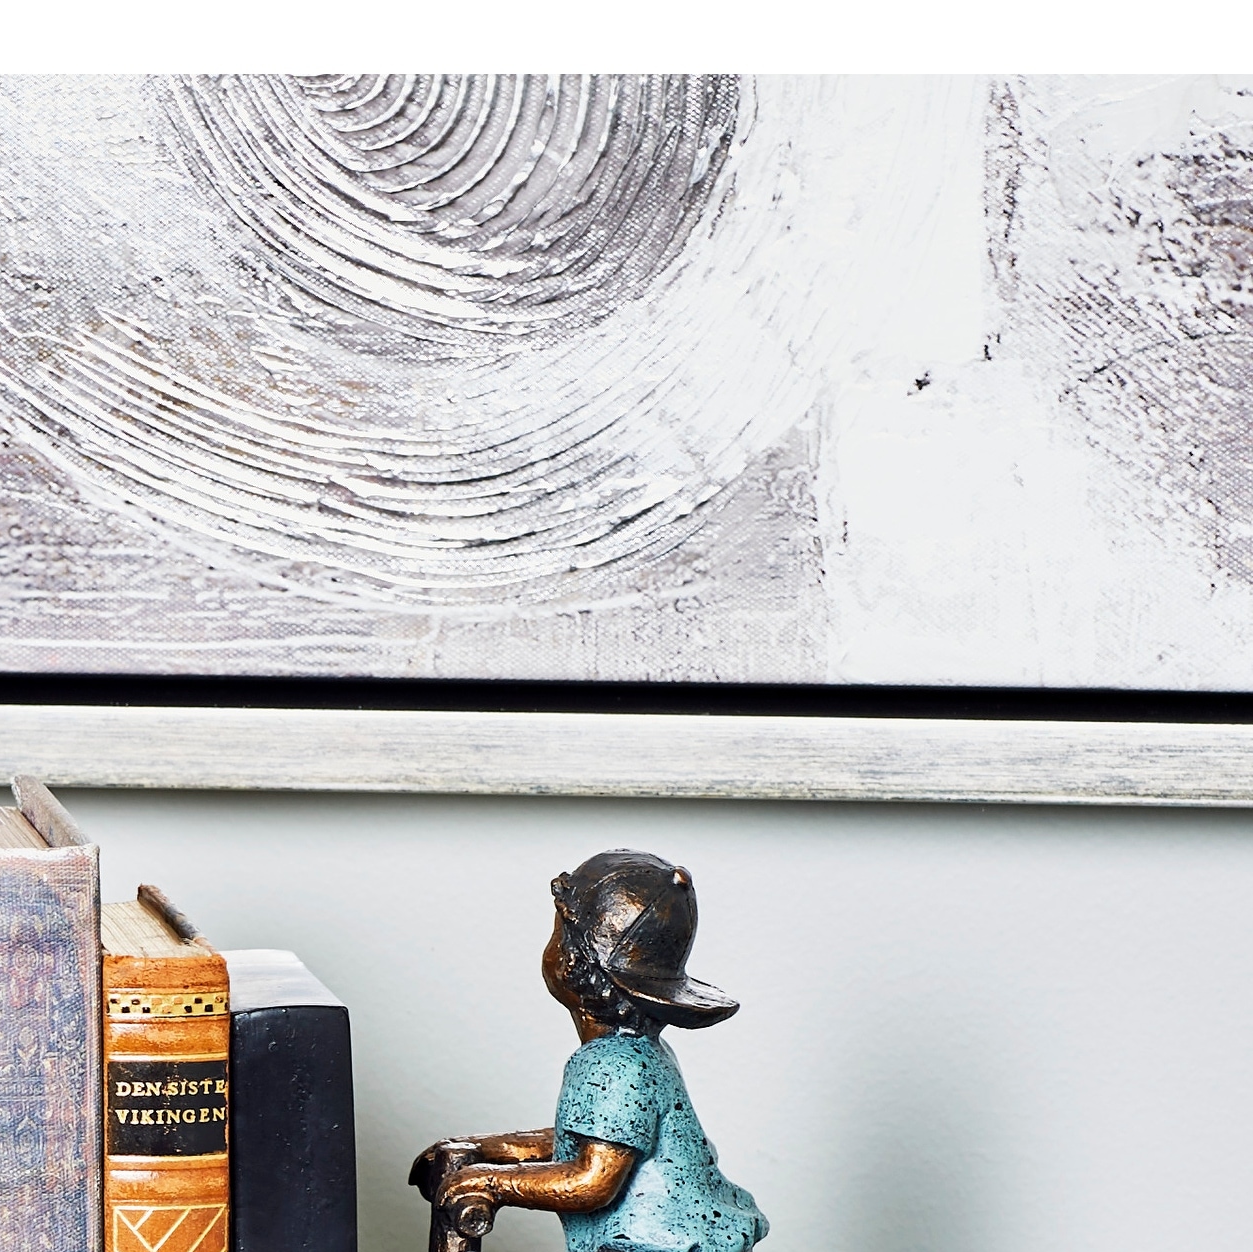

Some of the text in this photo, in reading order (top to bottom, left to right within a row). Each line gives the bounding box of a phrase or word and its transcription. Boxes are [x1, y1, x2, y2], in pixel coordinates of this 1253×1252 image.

[115, 1079, 225, 1097] DEN SISTE
[115, 1106, 226, 1125] VIKINGEN
